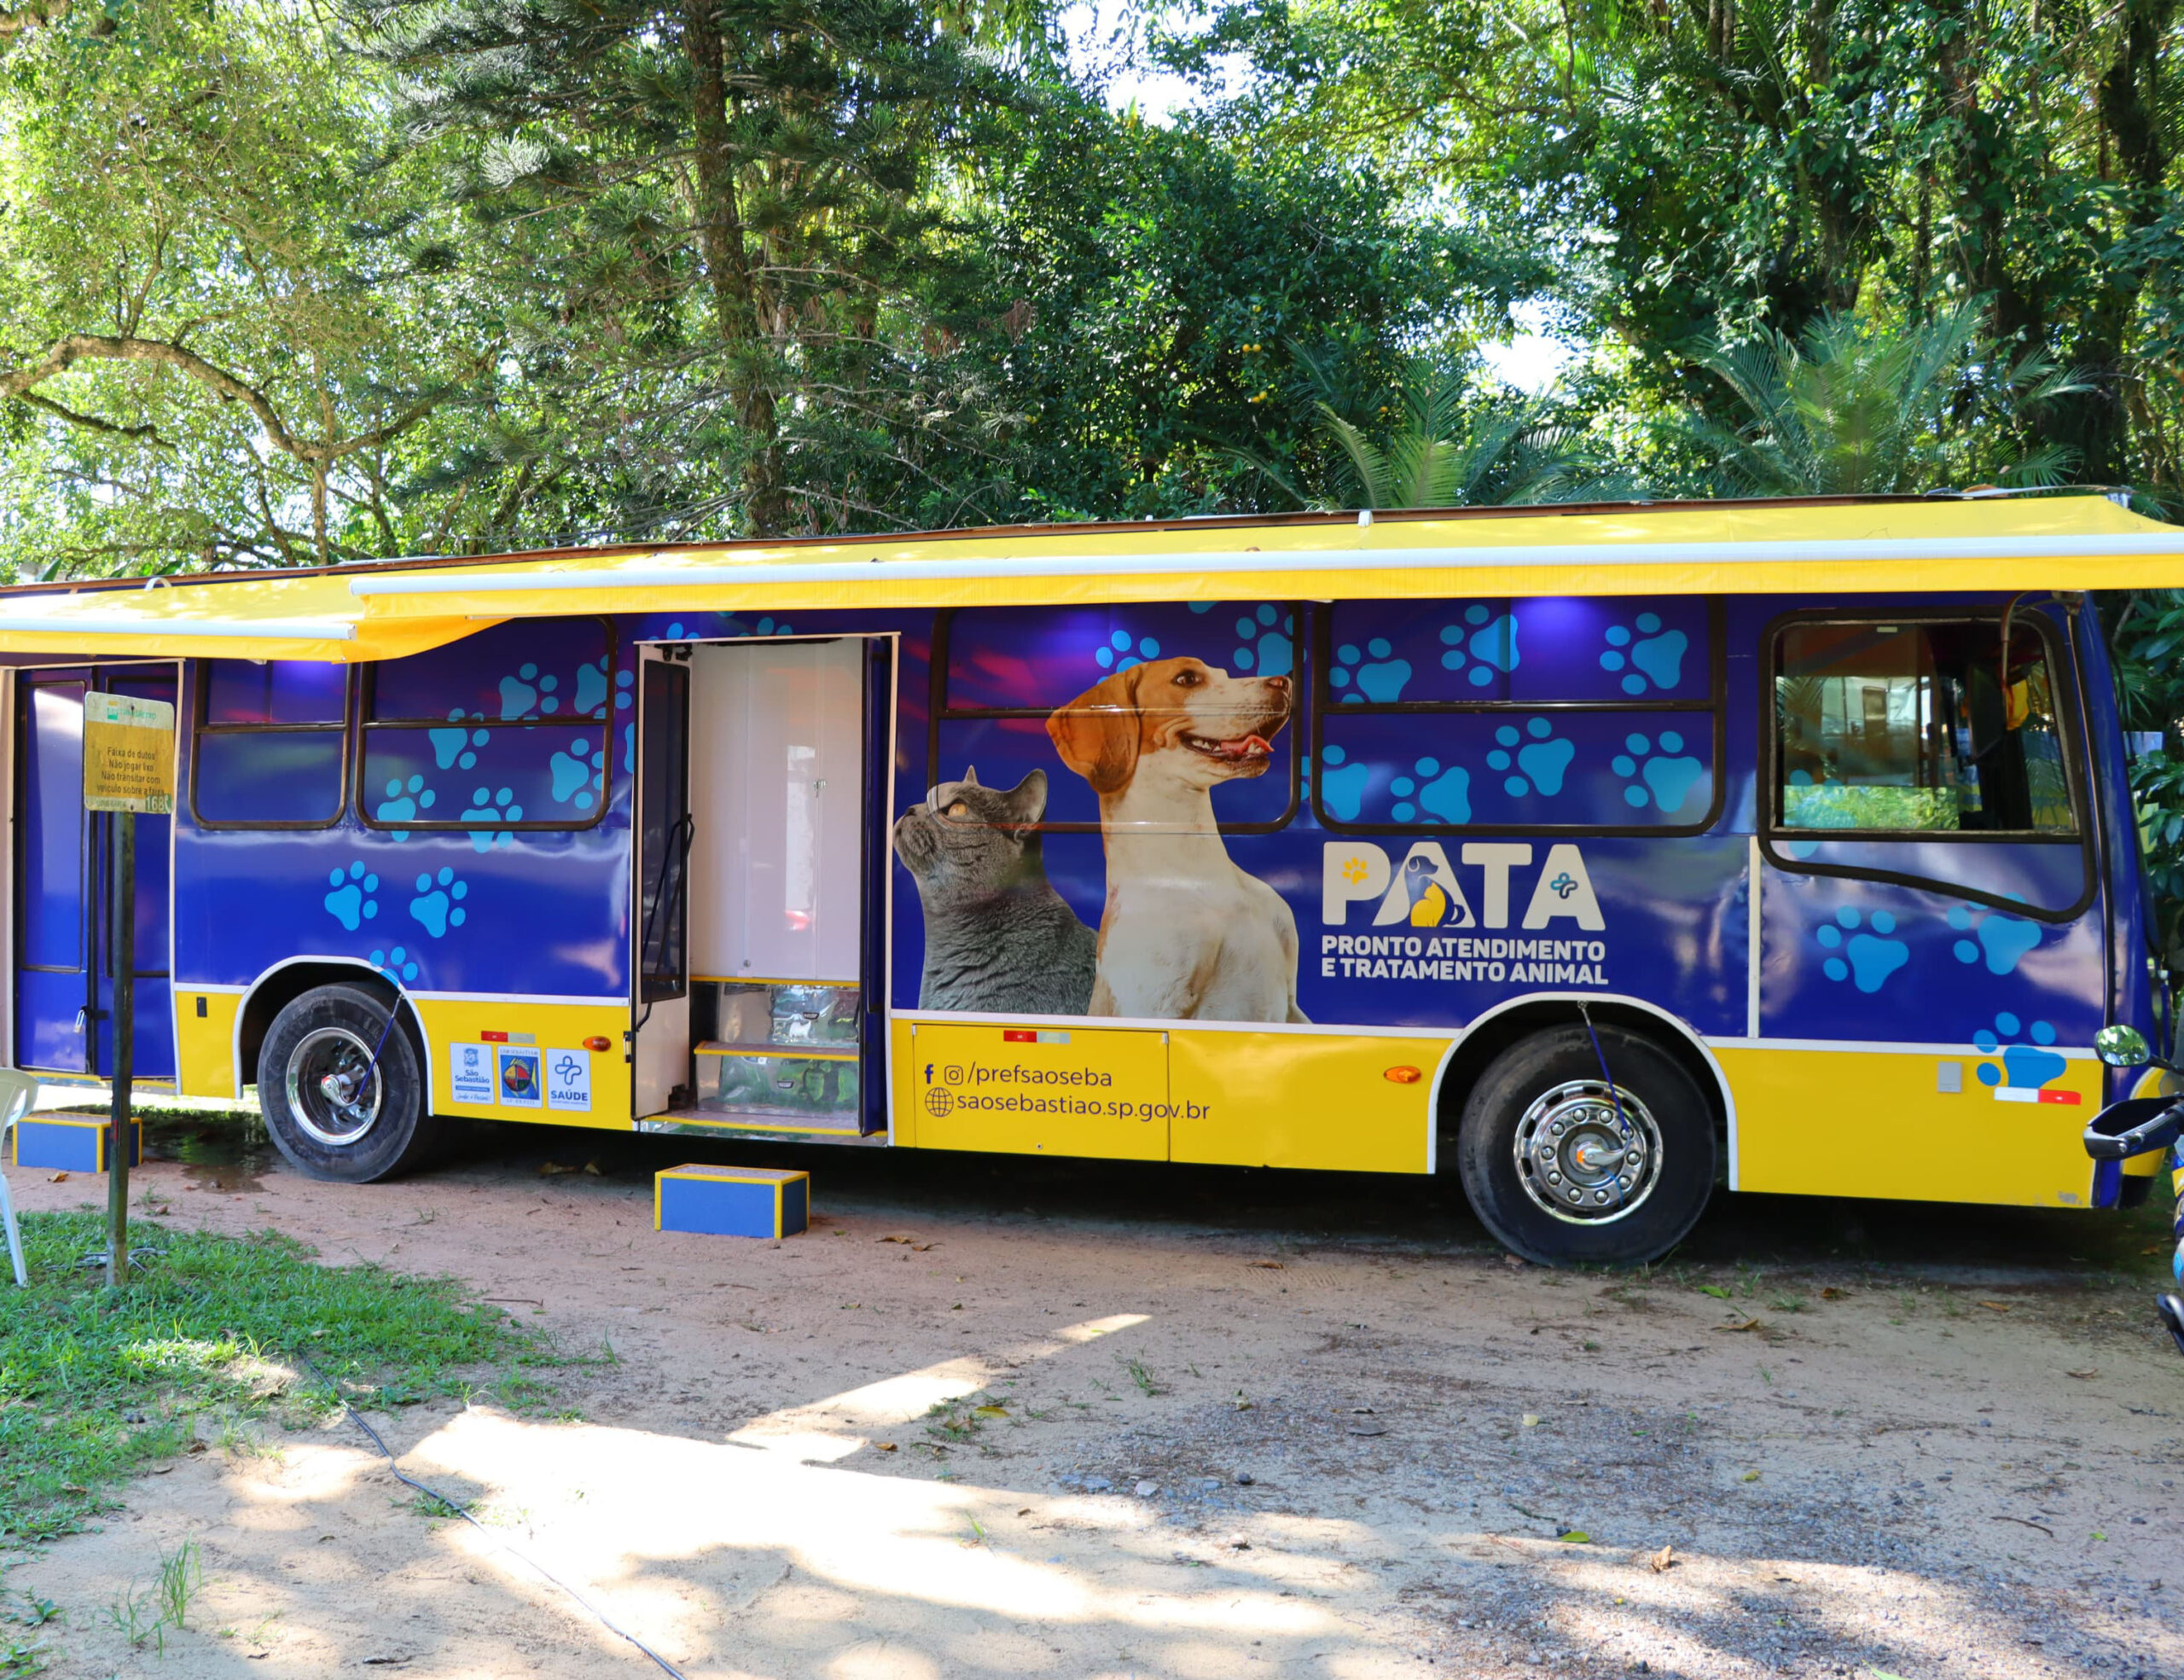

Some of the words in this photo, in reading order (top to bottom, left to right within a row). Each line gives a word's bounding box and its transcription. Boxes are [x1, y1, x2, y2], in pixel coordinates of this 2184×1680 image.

[107, 747, 126, 758] Faixa
[127, 748, 136, 758] de
[136, 750, 155, 760] dutos
[108, 759, 123, 769] Não
[124, 761, 142, 771] jogar
[102, 771, 116, 781] Não
[117, 772, 145, 782] transitar
[123, 785, 142, 794] sobre
[146, 794, 164, 811] 168
[1321, 840, 1606, 931] PATA
[1321, 935, 1422, 957] PRONTO
[1426, 937, 1606, 962] ATENDIMENTO
[1321, 957, 1336, 977] E
[1344, 958, 1506, 981] TRATAMENTO
[1509, 962, 1609, 985] ANIMAL
[455, 1074, 491, 1084] Sebastião
[465, 1068, 479, 1077] São
[967, 1061, 1112, 1087] /prefsaoseba
[550, 1089, 588, 1102] SAÚDE
[956, 1092, 1211, 1123] saosebastiao.sp.gov.br
